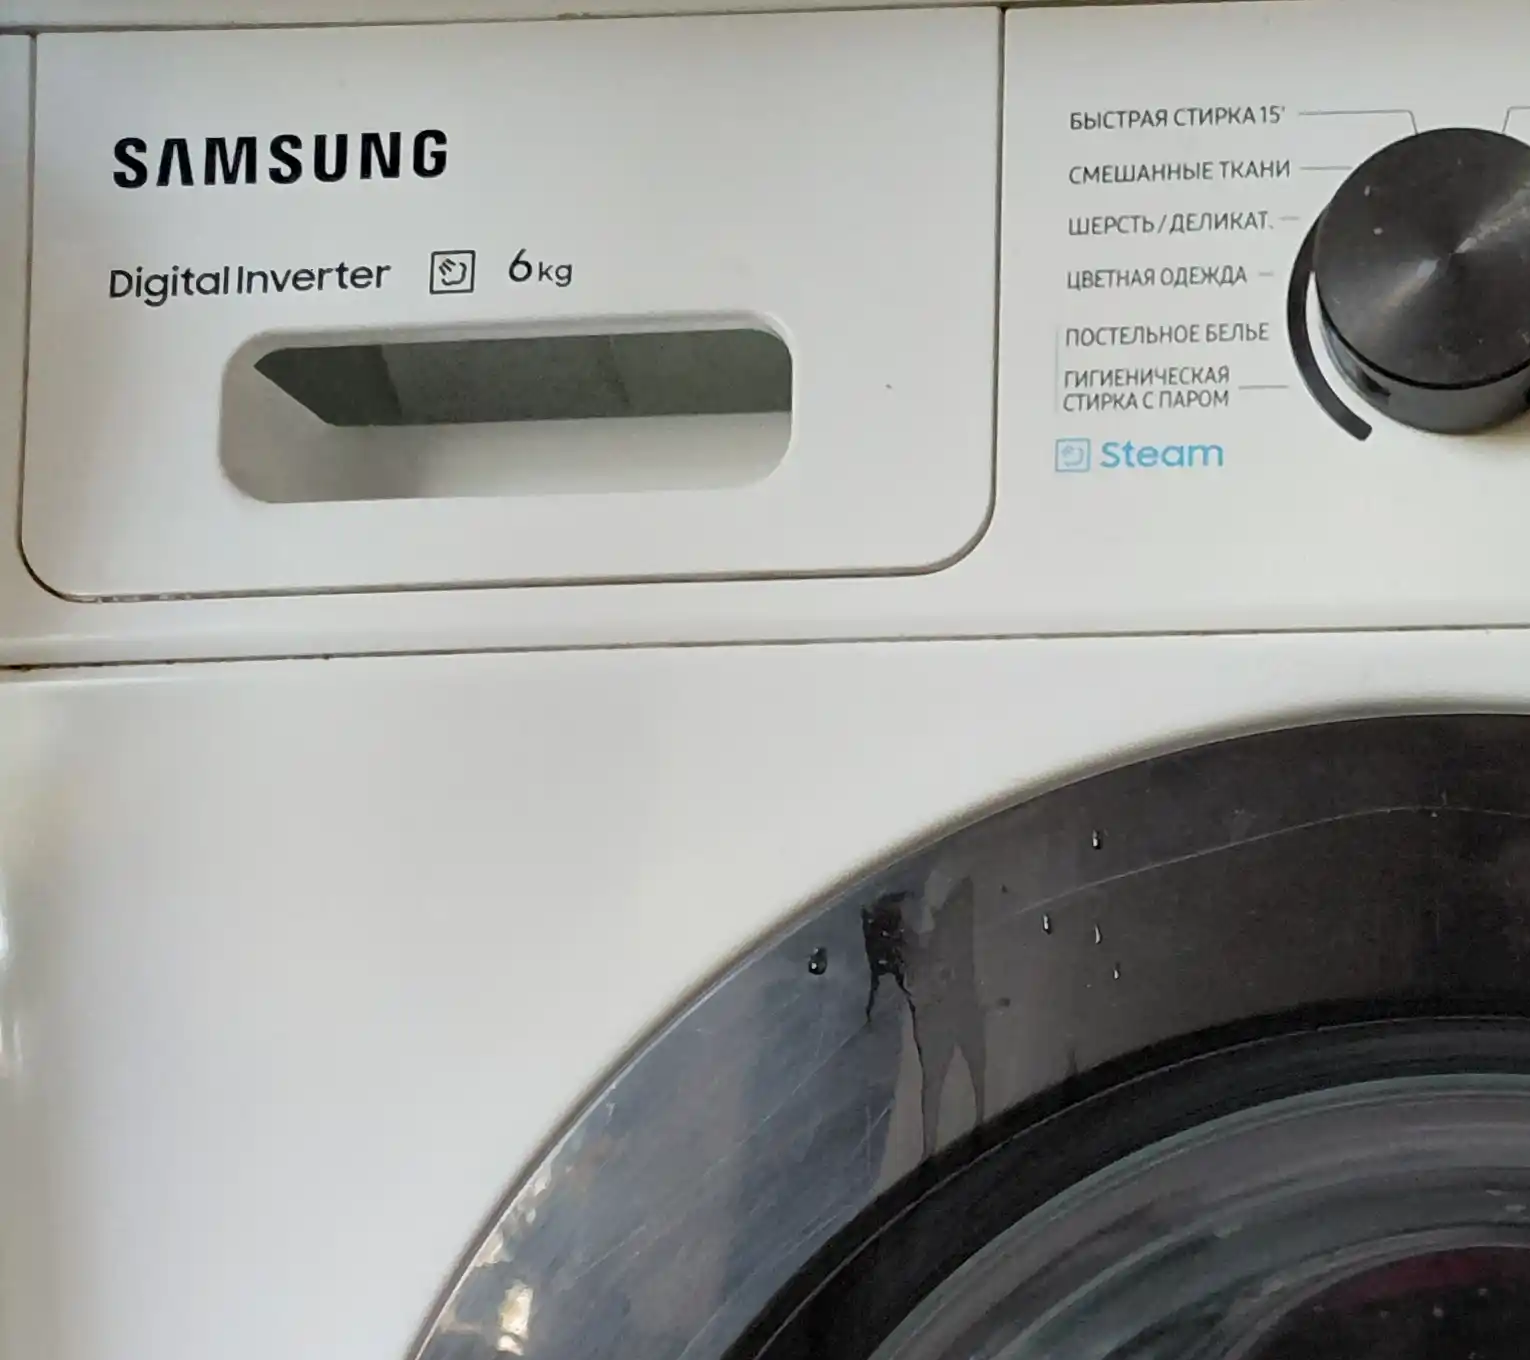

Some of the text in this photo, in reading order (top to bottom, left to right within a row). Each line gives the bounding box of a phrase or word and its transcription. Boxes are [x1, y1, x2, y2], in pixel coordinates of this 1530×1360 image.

[1070, 108, 1168, 131] БЫСТРАЯ
[1173, 106, 1257, 127] СТИРКА
[112, 129, 448, 190] SAMSUNG
[1068, 159, 1291, 185] СМЕШАННЫЕ ТКАНИ
[1066, 264, 1248, 292] ЦВЕТНАЯ ОДЕЖДА
[1065, 322, 1270, 347] ПОСТЕЛЬНОЕ БЕЛЬЕ
[1064, 366, 1230, 388] ГИГИЕНИЧЕСКАЯ
[1063, 390, 1229, 412] СТИРКА С ПАРОМ
[1100, 440, 1224, 468] Steam
